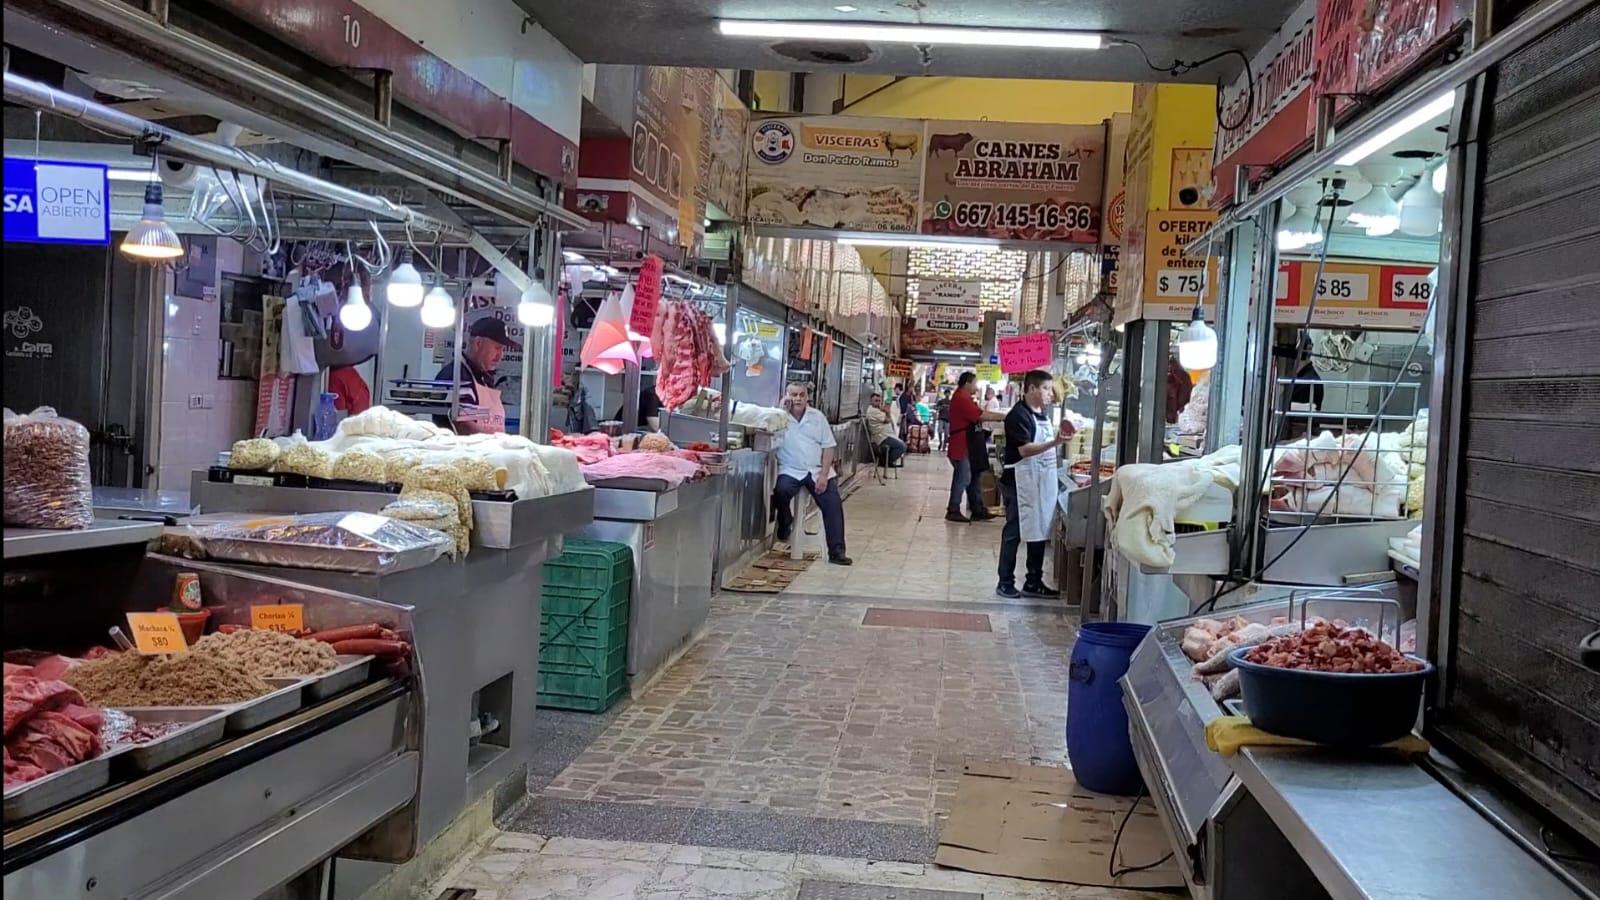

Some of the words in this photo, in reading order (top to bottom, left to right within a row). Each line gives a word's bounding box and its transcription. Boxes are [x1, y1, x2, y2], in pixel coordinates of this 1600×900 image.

[343, 14, 360, 48] 10
[815, 134, 880, 148] VISCERAS
[975, 141, 1061, 160] CARNES
[803, 153, 827, 164] Don
[828, 154, 860, 167] Pedro
[861, 157, 899, 168] Ramos
[954, 160, 1079, 181] ABRAHAM
[41, 187, 100, 205] OPEN
[42, 205, 100, 218] ABIERTO
[956, 204, 991, 226] 667
[996, 206, 1090, 229] 145-16-36
[1159, 220, 1213, 233] OFERTA
[1161, 246, 1177, 257] de
[1167, 258, 1206, 268] entero
[1159, 276, 1169, 293] $
[1178, 275, 1199, 293] 75
[1317, 279, 1327, 296] $
[1330, 279, 1351, 298] 85
[1394, 281, 1404, 297] $
[1409, 282, 1430, 300] 48
[151, 636, 169, 647] $80
